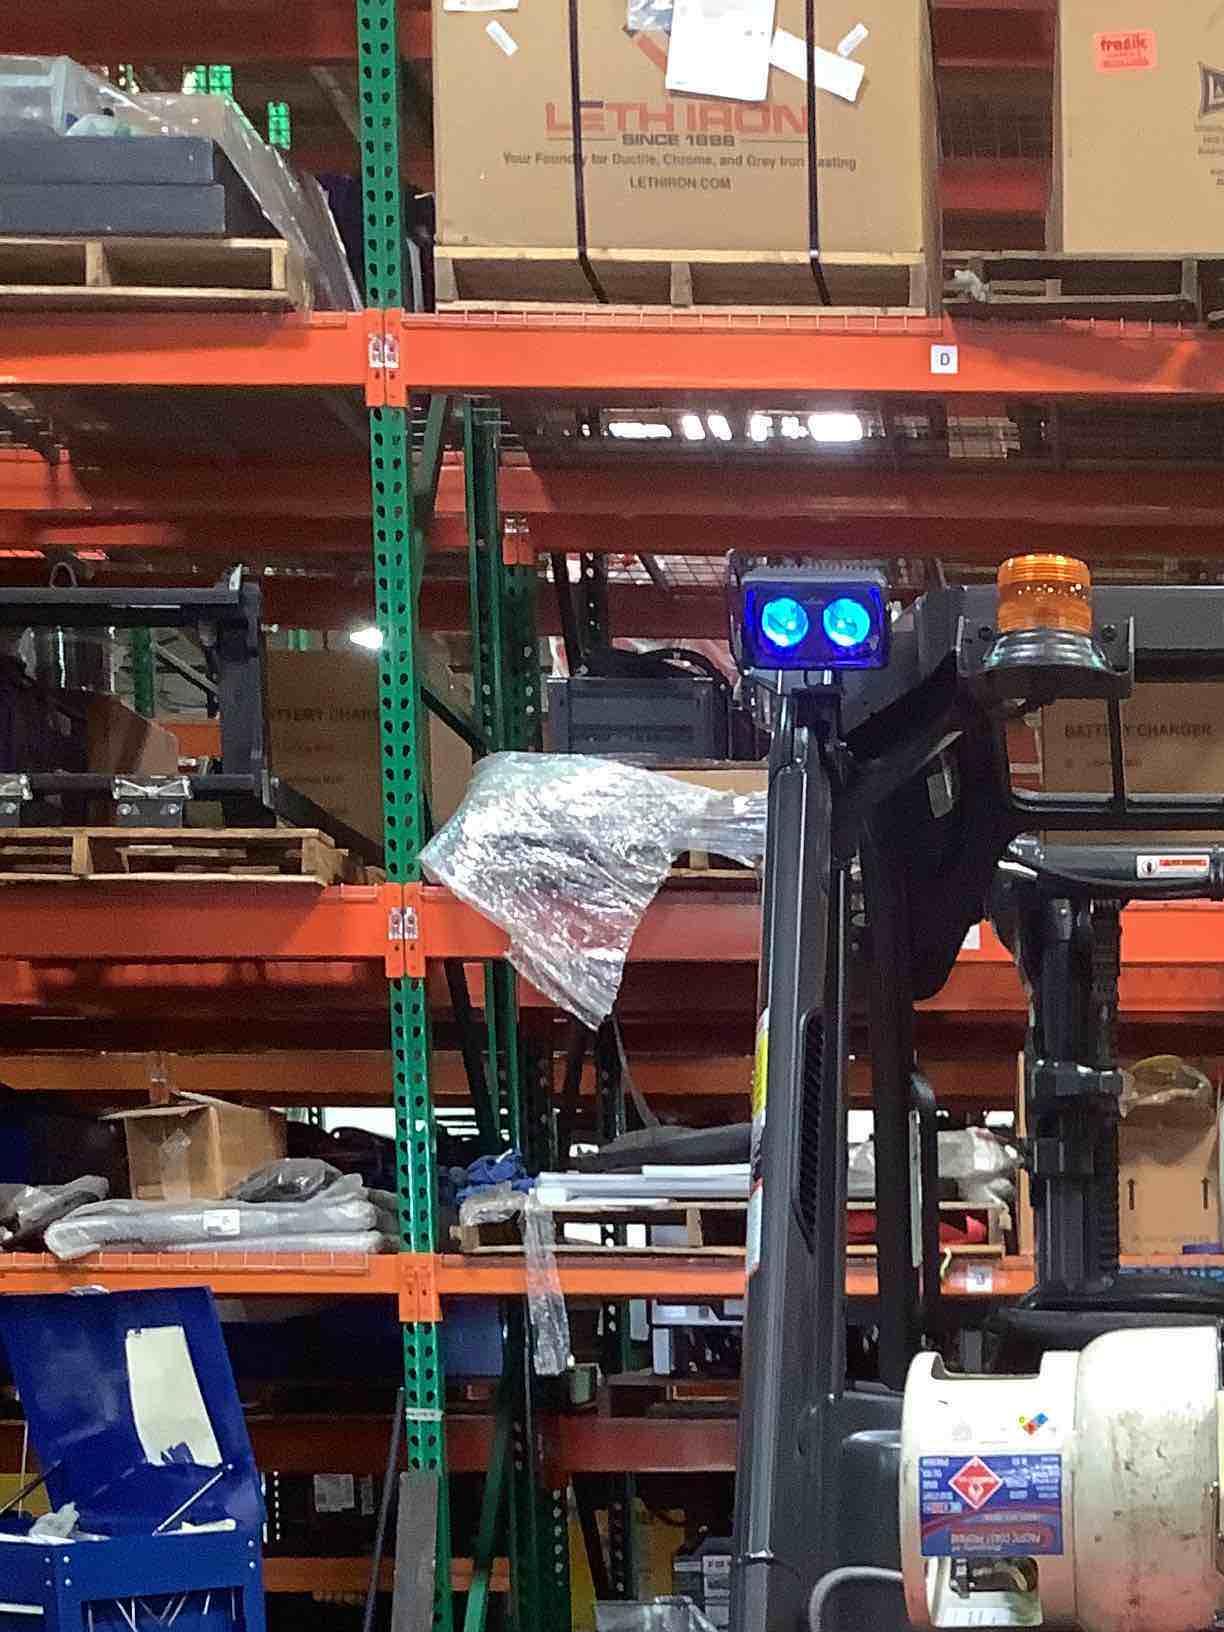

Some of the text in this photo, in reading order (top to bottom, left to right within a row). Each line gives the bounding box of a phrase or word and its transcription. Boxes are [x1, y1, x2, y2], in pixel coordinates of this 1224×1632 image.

[622, 133, 680, 146] SINCE
[504, 152, 530, 165] Your
[535, 152, 587, 168] Foundy
[720, 154, 743, 168] and
[817, 157, 857, 171] asting
[940, 352, 951, 366] D
